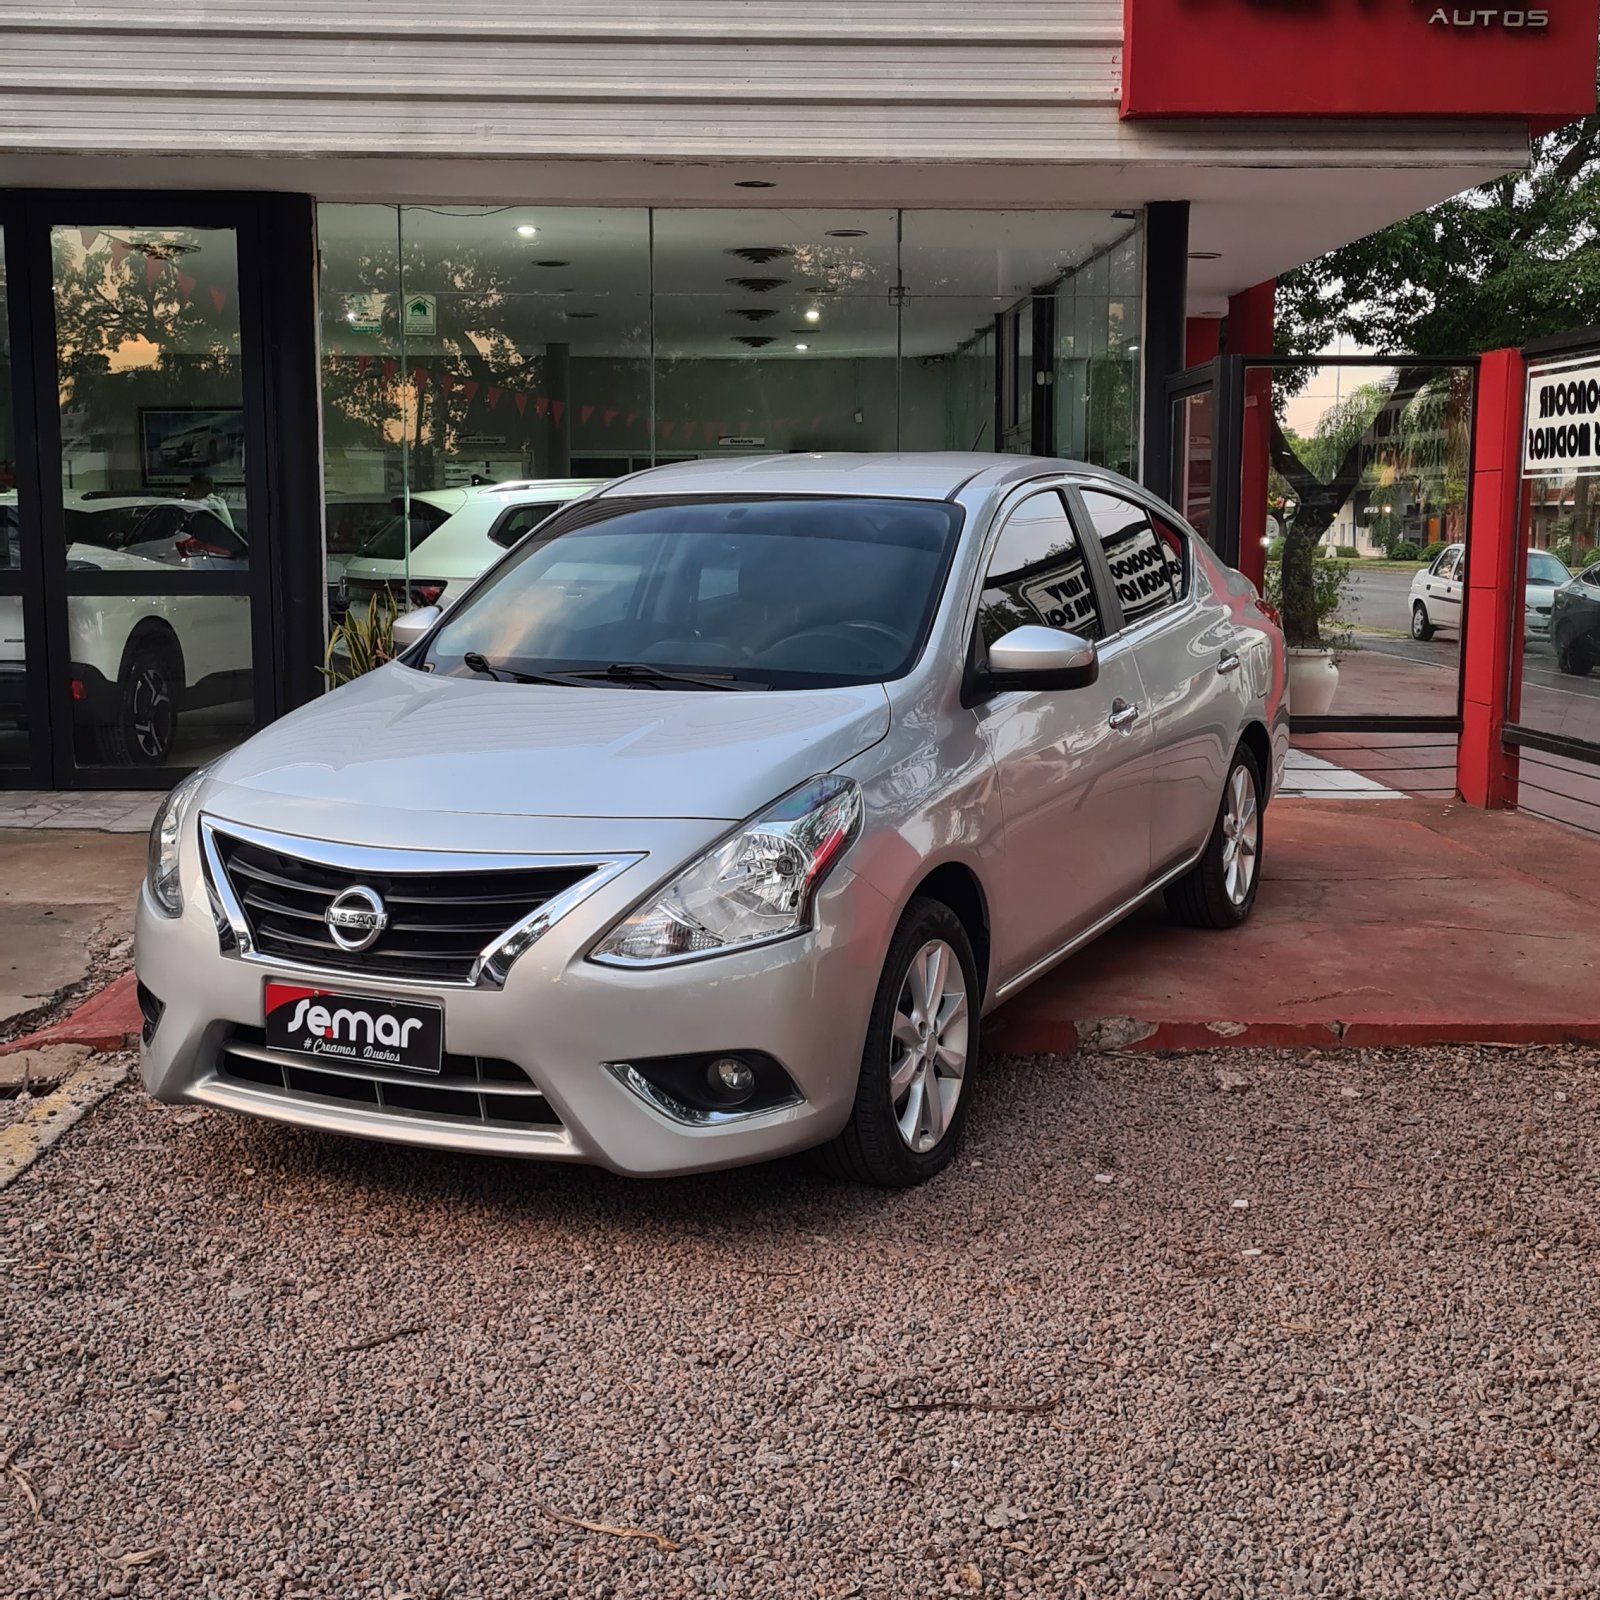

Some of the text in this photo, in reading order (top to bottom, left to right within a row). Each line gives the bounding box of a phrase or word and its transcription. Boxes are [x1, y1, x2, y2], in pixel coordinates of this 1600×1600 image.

[1428, 7, 1548, 26] AUTOS
[328, 911, 377, 926] NISSAN
[362, 1045, 401, 1062] Dueños
